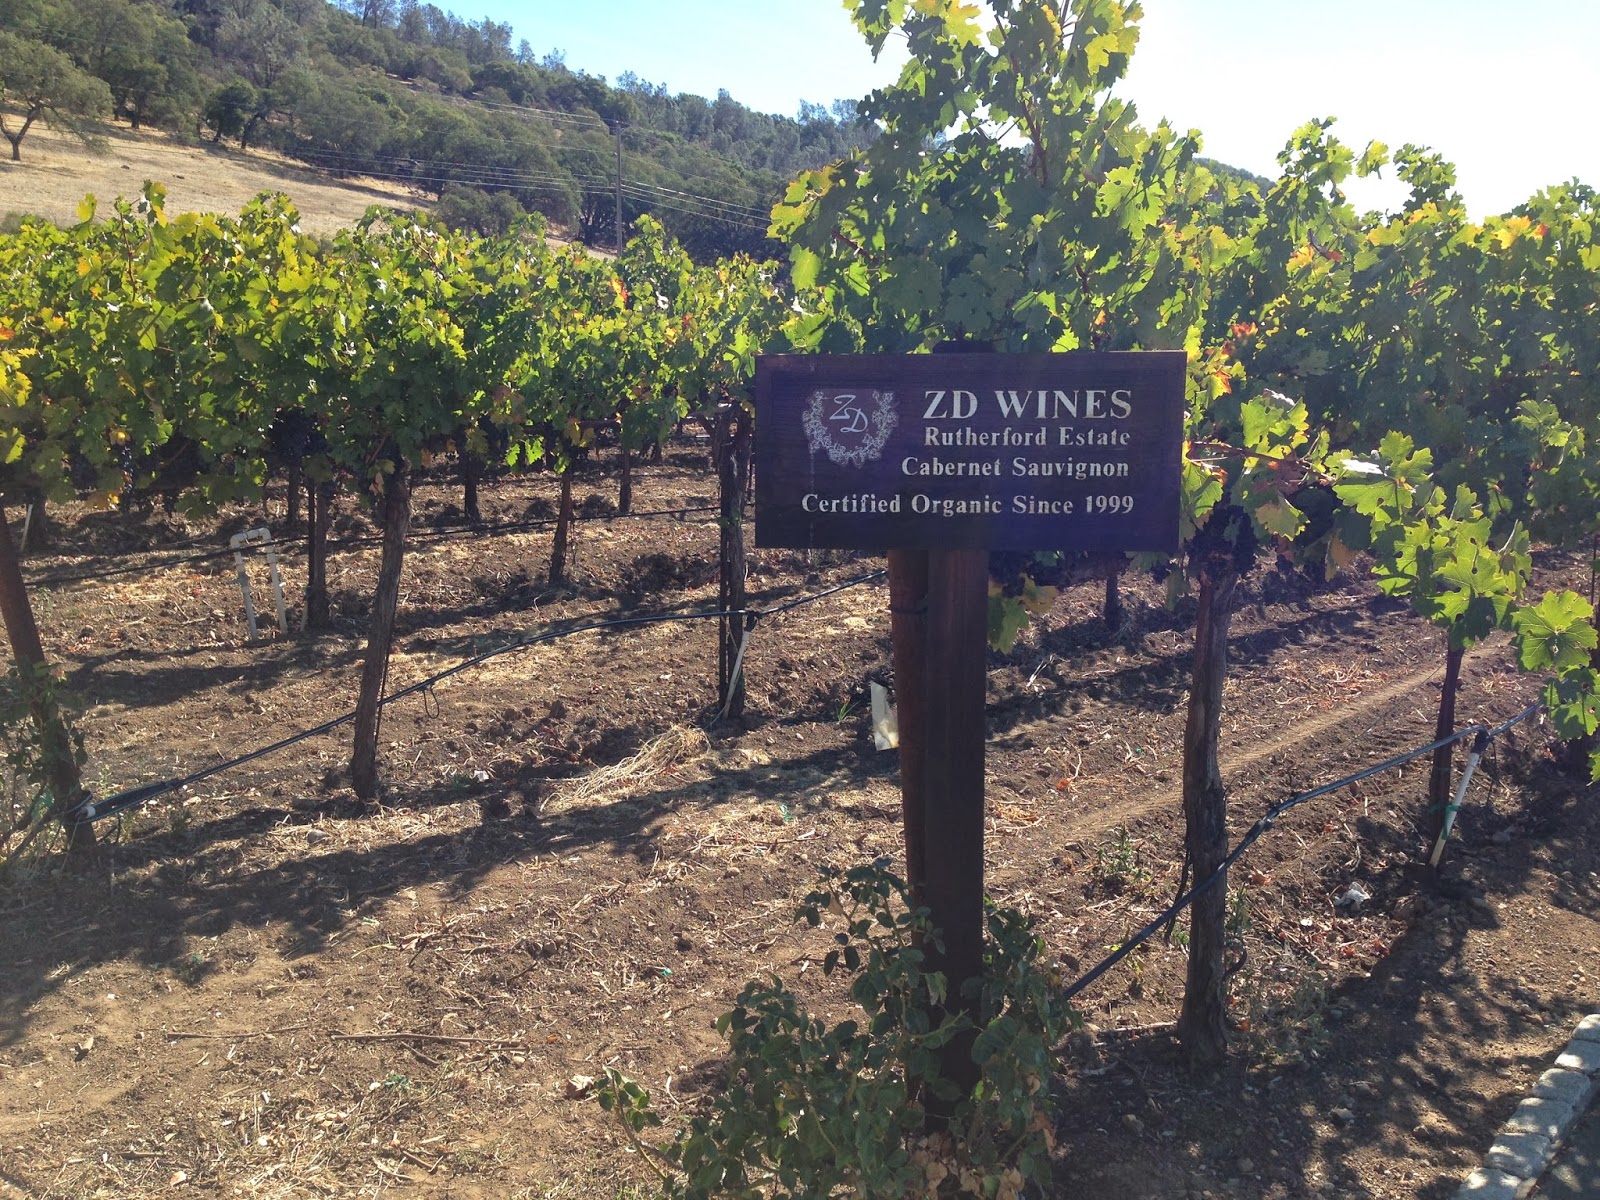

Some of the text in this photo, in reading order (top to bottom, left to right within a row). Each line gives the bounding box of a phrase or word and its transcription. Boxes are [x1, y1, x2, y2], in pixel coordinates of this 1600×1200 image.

[828, 394, 869, 435] ZD
[923, 389, 1131, 419] ZD WINES
[924, 426, 1131, 447] Rutherford Estate
[901, 456, 1129, 481] Cabernet Sauvignon
[801, 493, 1134, 517] Certified Organic Since 1999
